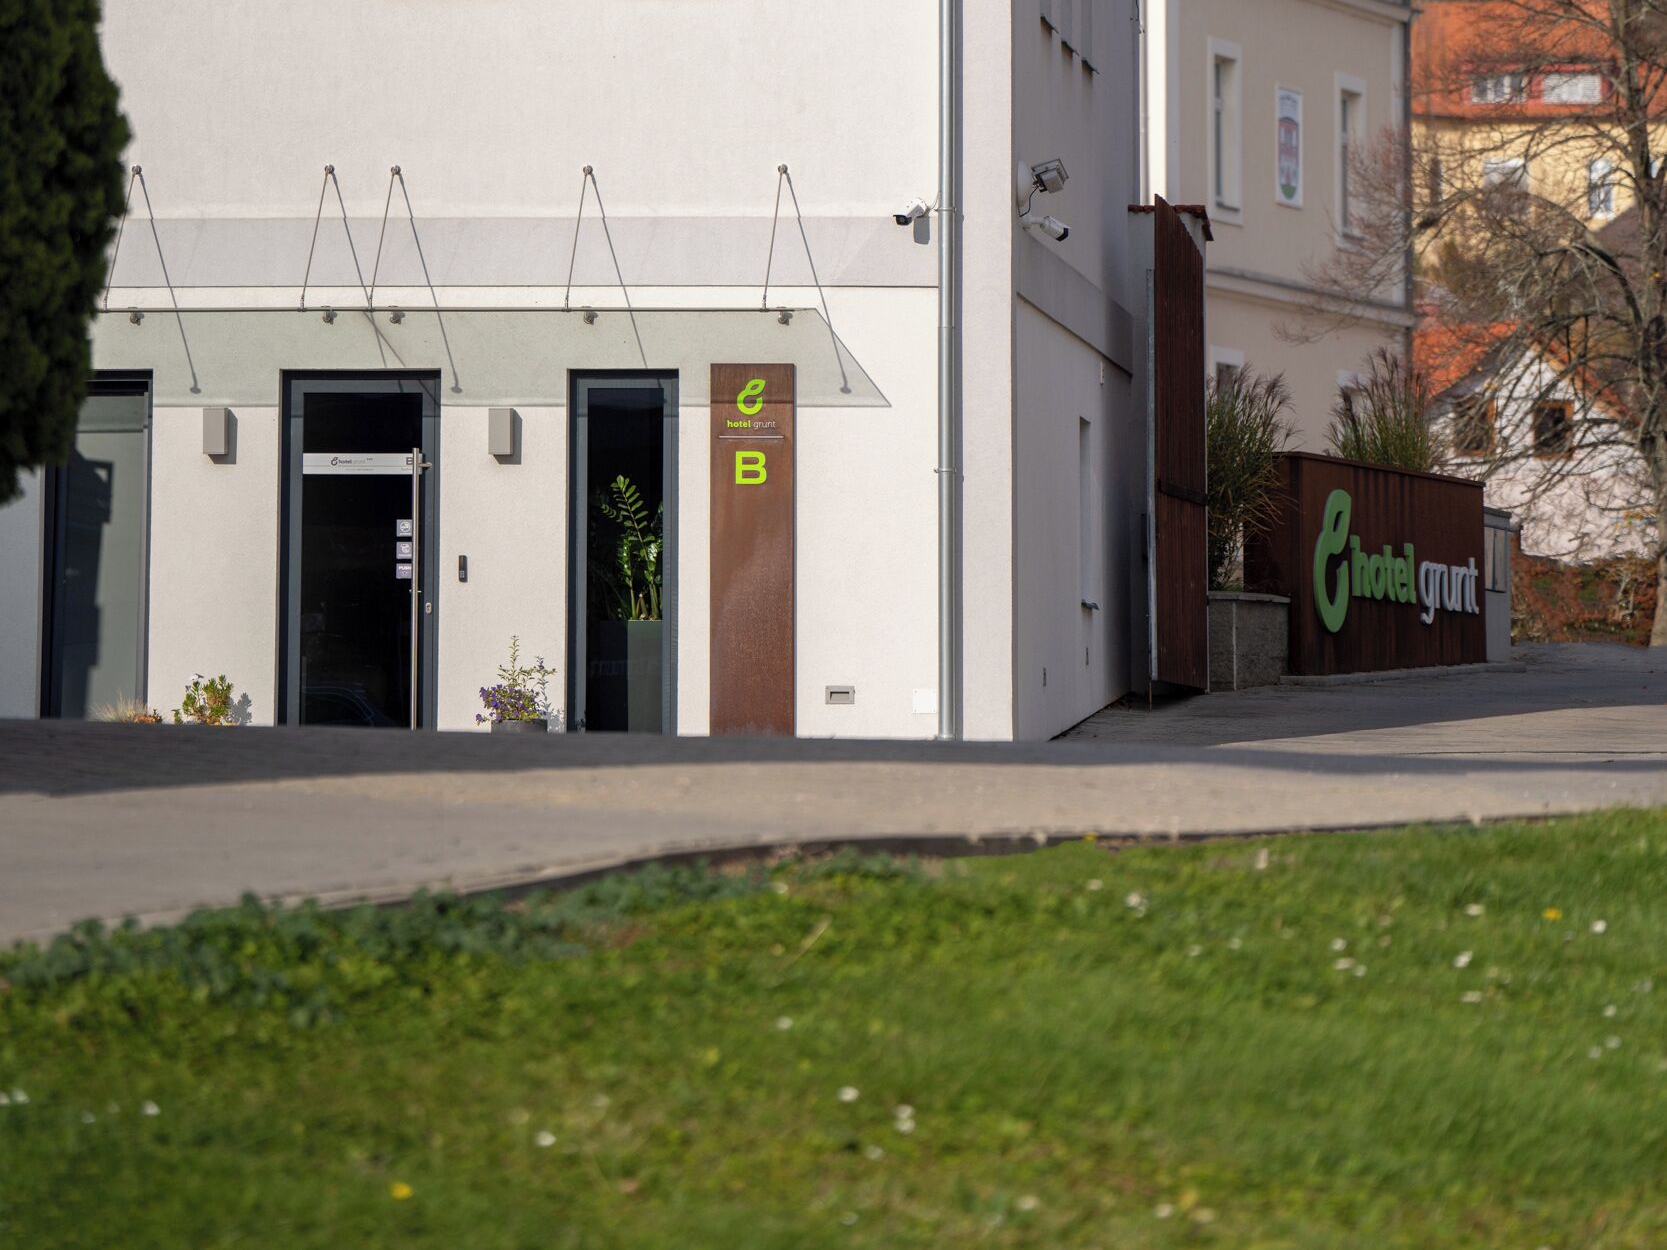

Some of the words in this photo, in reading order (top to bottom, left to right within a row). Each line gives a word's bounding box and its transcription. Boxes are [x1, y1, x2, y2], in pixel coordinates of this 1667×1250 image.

[727, 420, 751, 428] hotel
[753, 421, 776, 429] grunt
[735, 451, 767, 484] B
[1350, 535, 1416, 604] hotel
[1419, 557, 1479, 625] grunt
